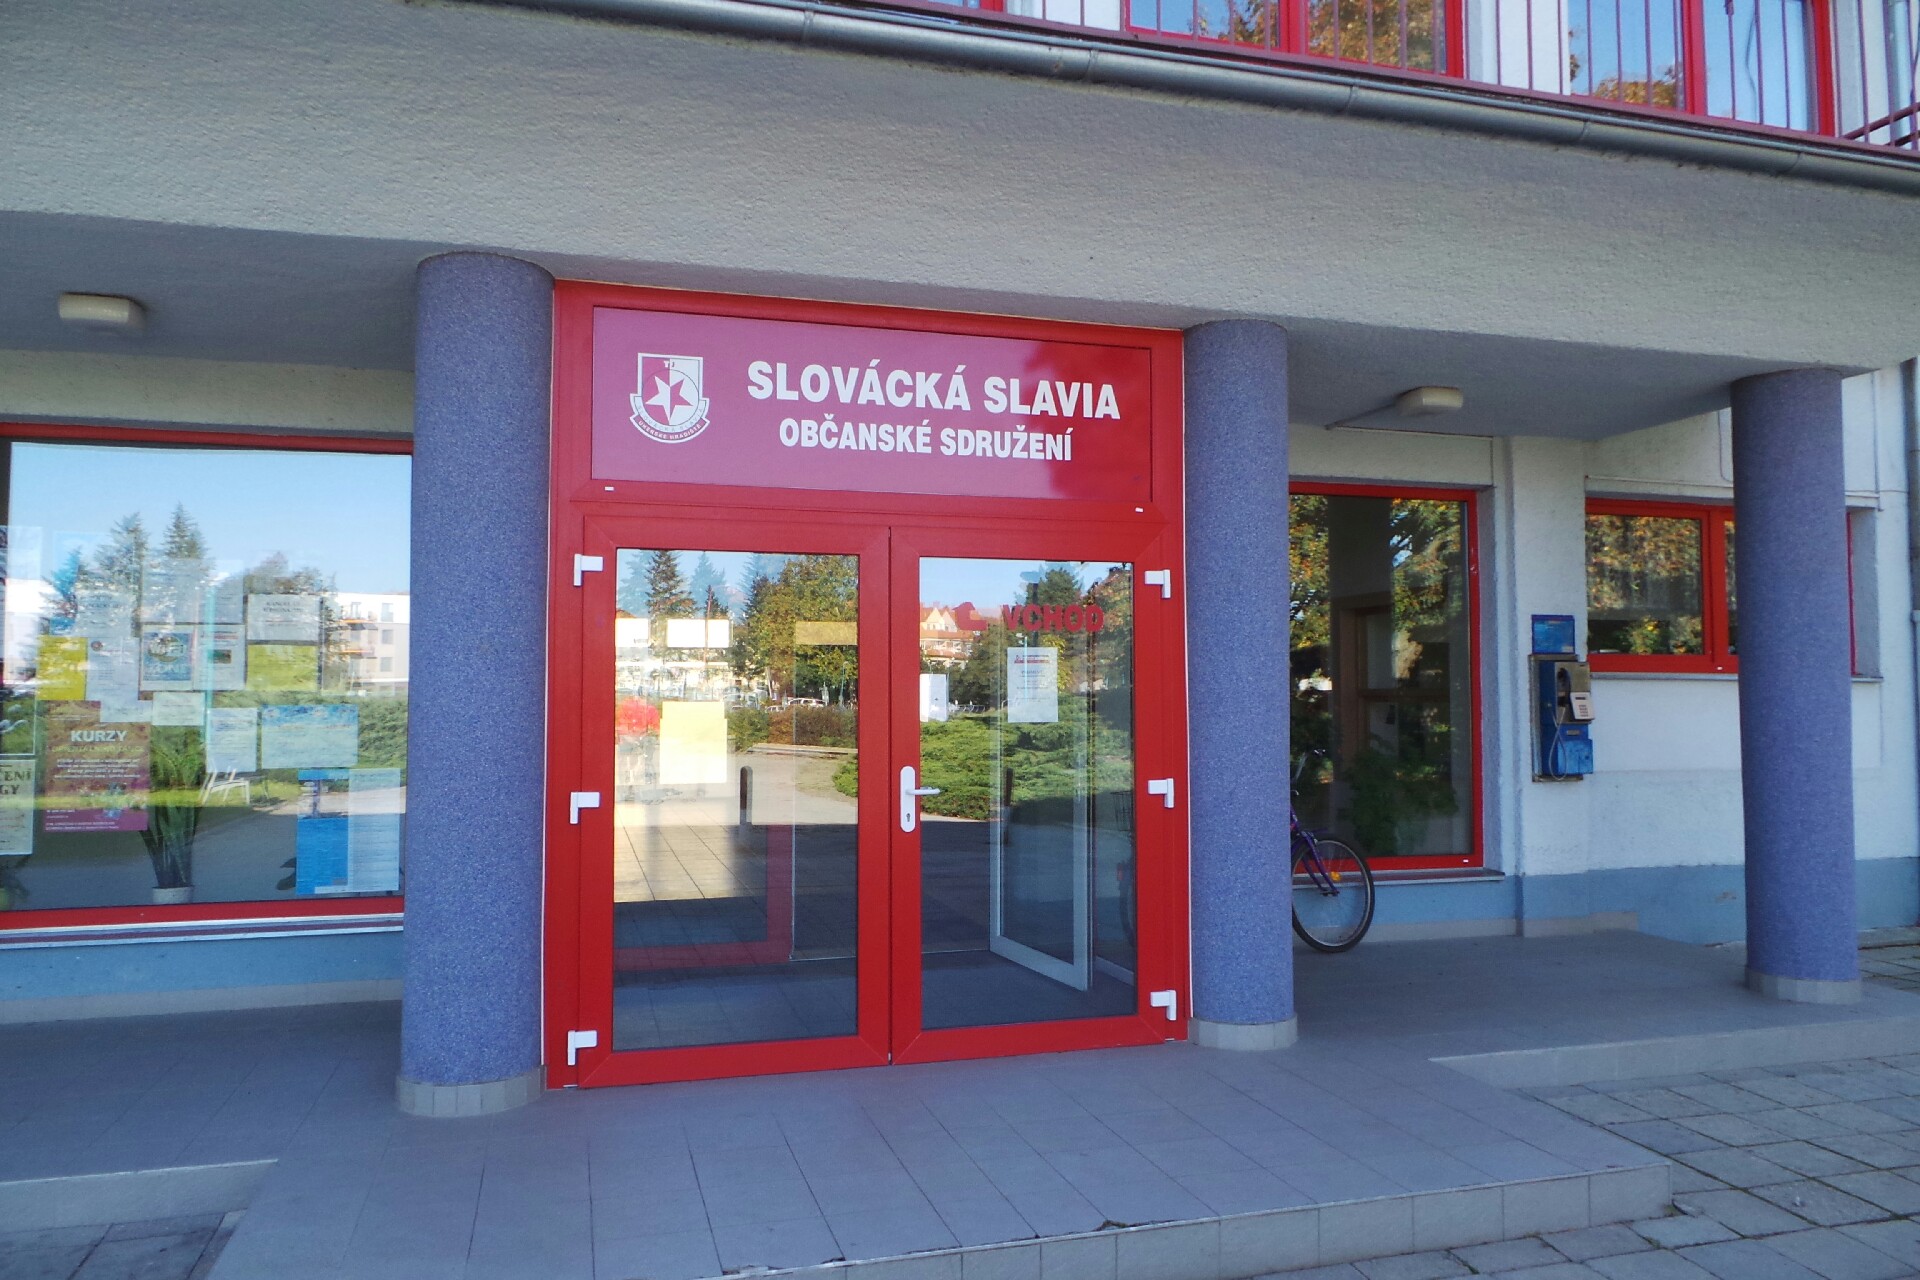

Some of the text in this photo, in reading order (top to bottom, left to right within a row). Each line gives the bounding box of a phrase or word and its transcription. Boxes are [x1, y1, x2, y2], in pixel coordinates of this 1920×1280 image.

[746, 358, 1121, 420] SLOVÁCKÁ SLAVIA
[779, 413, 1074, 461] OBČANSKÉ SDRUŽENÍ
[1001, 604, 1105, 632] VCHOD
[71, 730, 127, 742] KURZY
